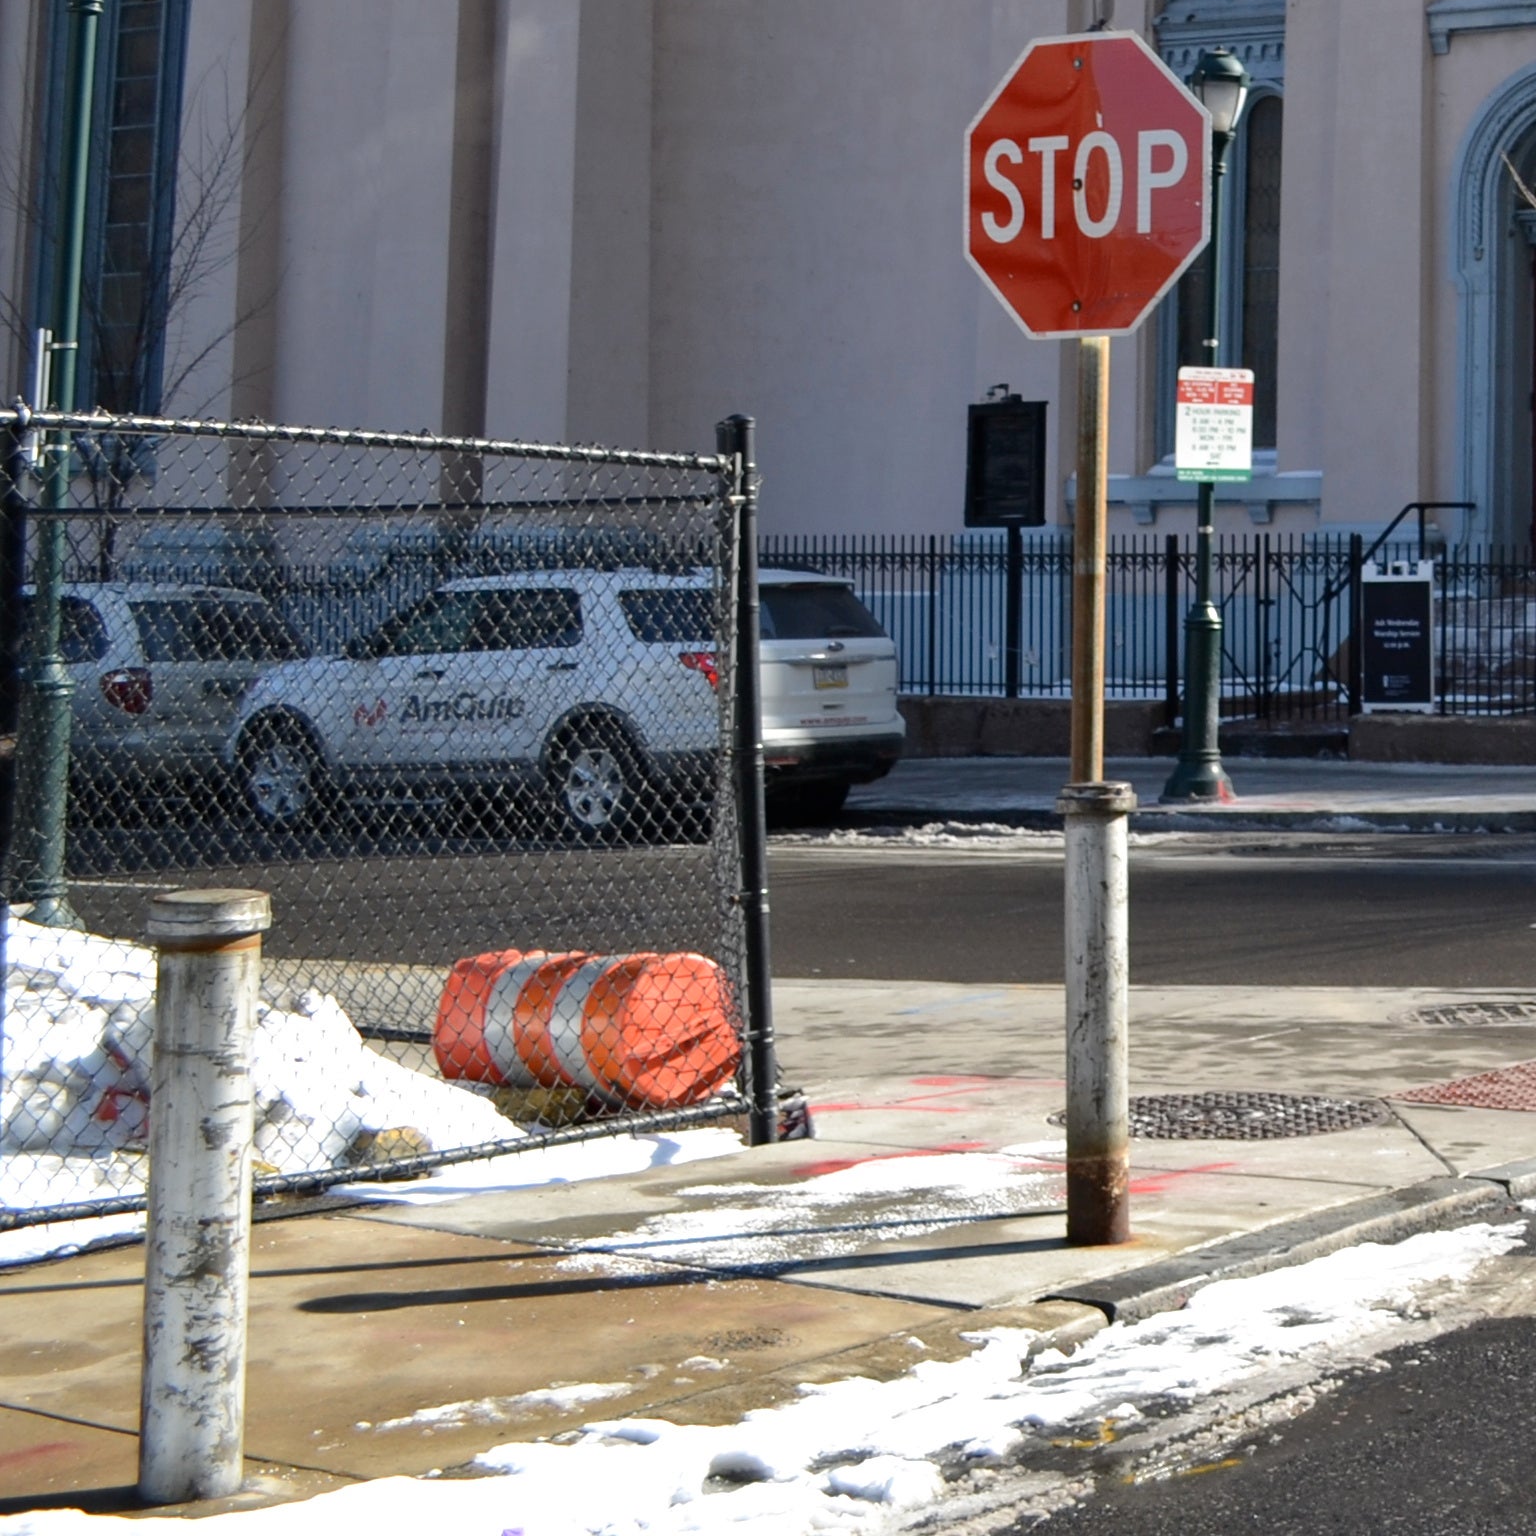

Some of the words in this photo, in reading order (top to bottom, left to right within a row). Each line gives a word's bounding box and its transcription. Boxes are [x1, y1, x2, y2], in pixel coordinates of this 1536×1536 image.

[981, 129, 1188, 244] STOP
[1184, 406, 1191, 416] 2
[400, 691, 526, 724] AmQuip
